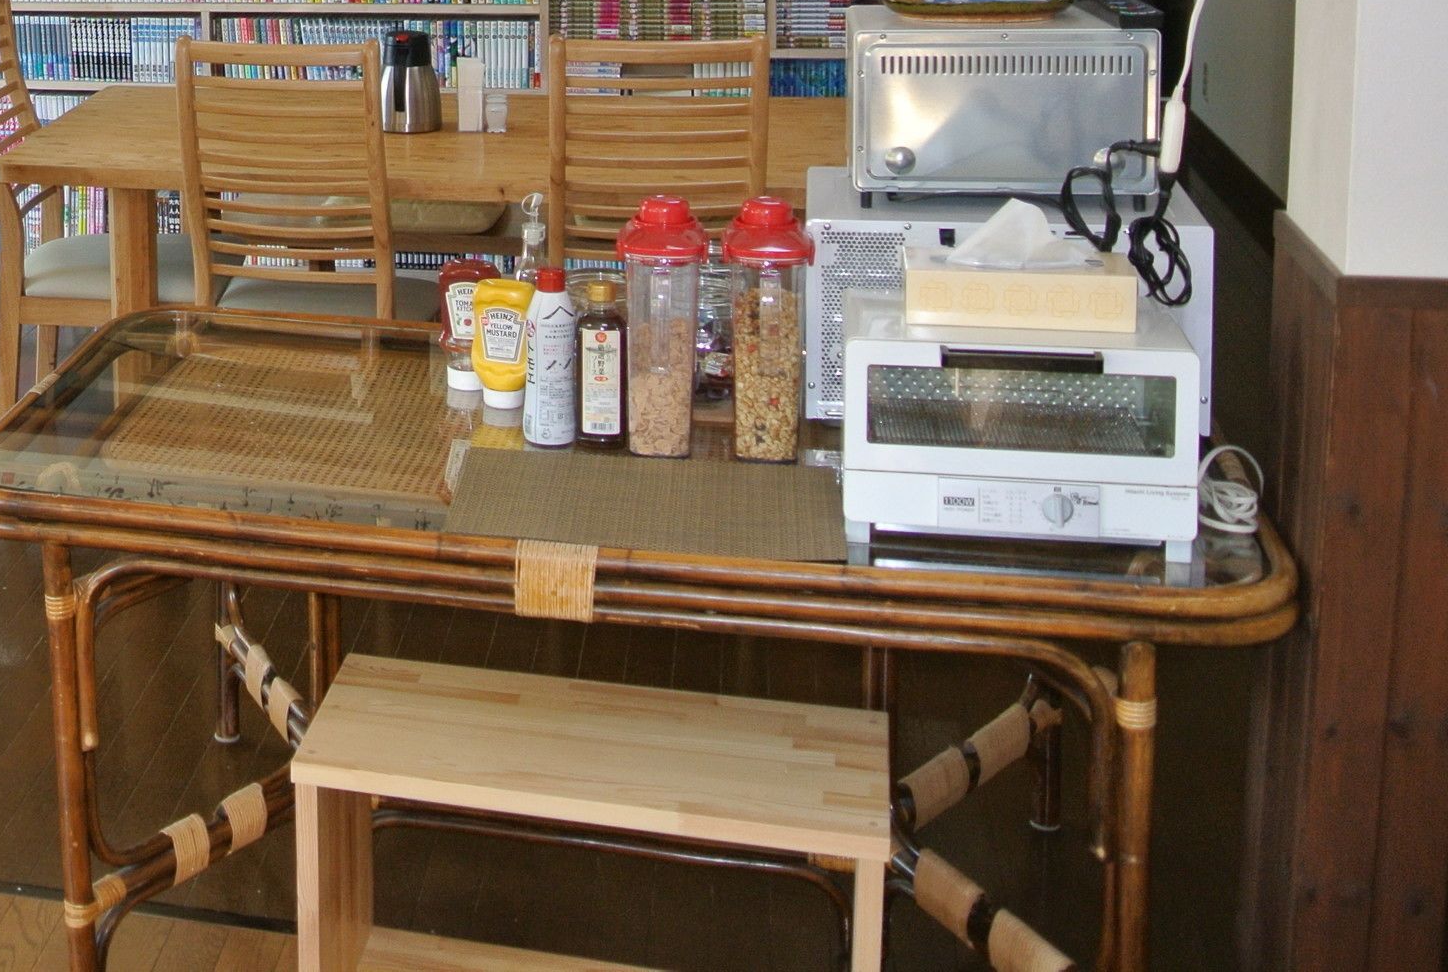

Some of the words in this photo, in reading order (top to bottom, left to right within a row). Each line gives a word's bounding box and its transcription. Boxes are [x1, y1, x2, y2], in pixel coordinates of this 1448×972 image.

[457, 287, 474, 295] HEIN
[490, 312, 515, 322] HEINZ
[490, 322, 514, 330] YELLOW
[486, 329, 518, 339] MUSTARD
[943, 496, 976, 507] 1100W
